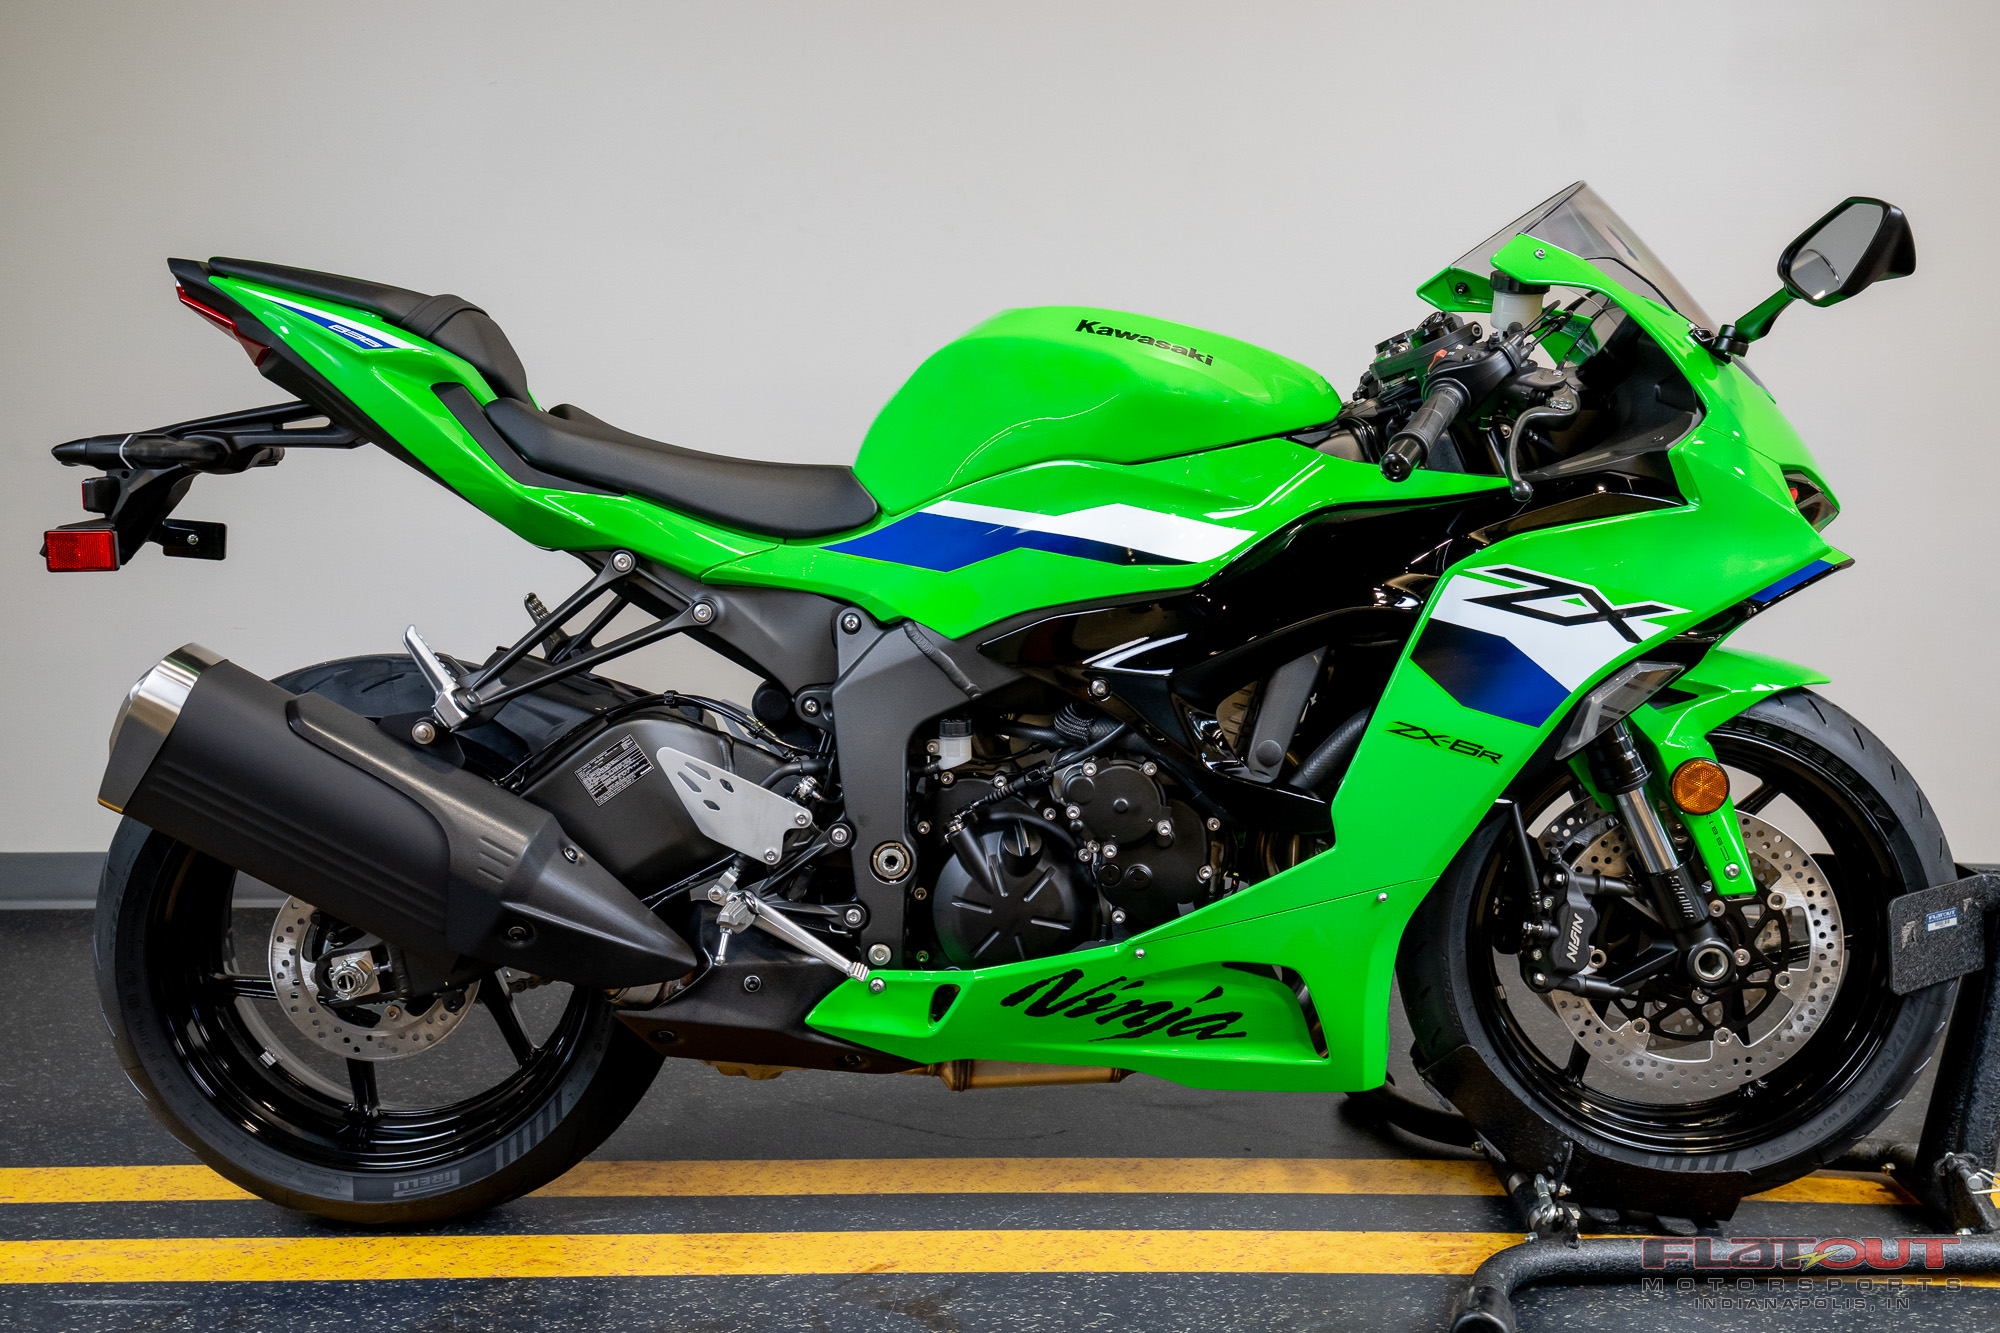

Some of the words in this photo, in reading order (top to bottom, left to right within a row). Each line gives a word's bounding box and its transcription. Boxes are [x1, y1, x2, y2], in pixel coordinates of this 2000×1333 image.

[1074, 317, 1215, 368] Kawasaki
[1462, 567, 1675, 645] ZX
[1385, 721, 1504, 765] ZX-6R
[1566, 912, 1584, 963] NISSIN
[1000, 968, 1247, 1042] Ninja
[392, 1169, 460, 1198] PIRELLI
